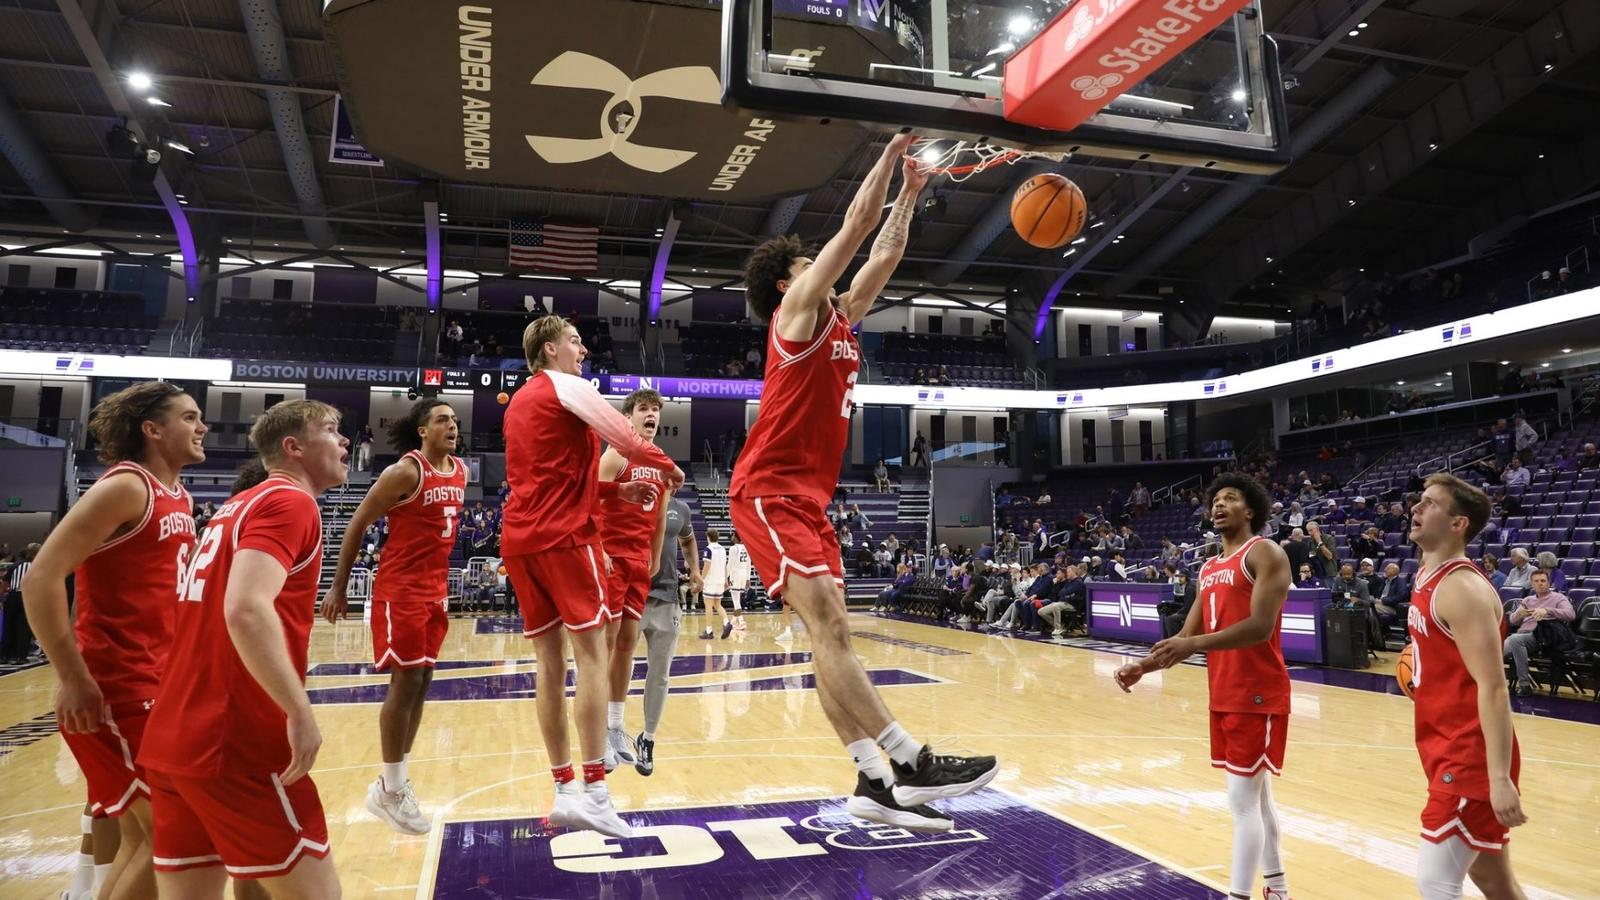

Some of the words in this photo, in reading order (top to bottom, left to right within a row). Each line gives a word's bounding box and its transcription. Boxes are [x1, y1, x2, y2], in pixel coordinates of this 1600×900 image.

[807, 5, 831, 16] FOULS
[835, 8, 843, 17] 0
[458, 5, 492, 92] UNDER
[461, 95, 491, 170] ARMOUR
[341, 150, 375, 159] WRESTLIN
[708, 144, 761, 191] UNDER
[236, 364, 307, 379] BOSTON
[313, 367, 415, 383] UNIVERSITY
[481, 373, 491, 386] 0
[740, 551, 748, 562] 22
[1200, 568, 1235, 591] OSTON
[1120, 595, 1131, 627] N
[1210, 592, 1217, 630] 1
